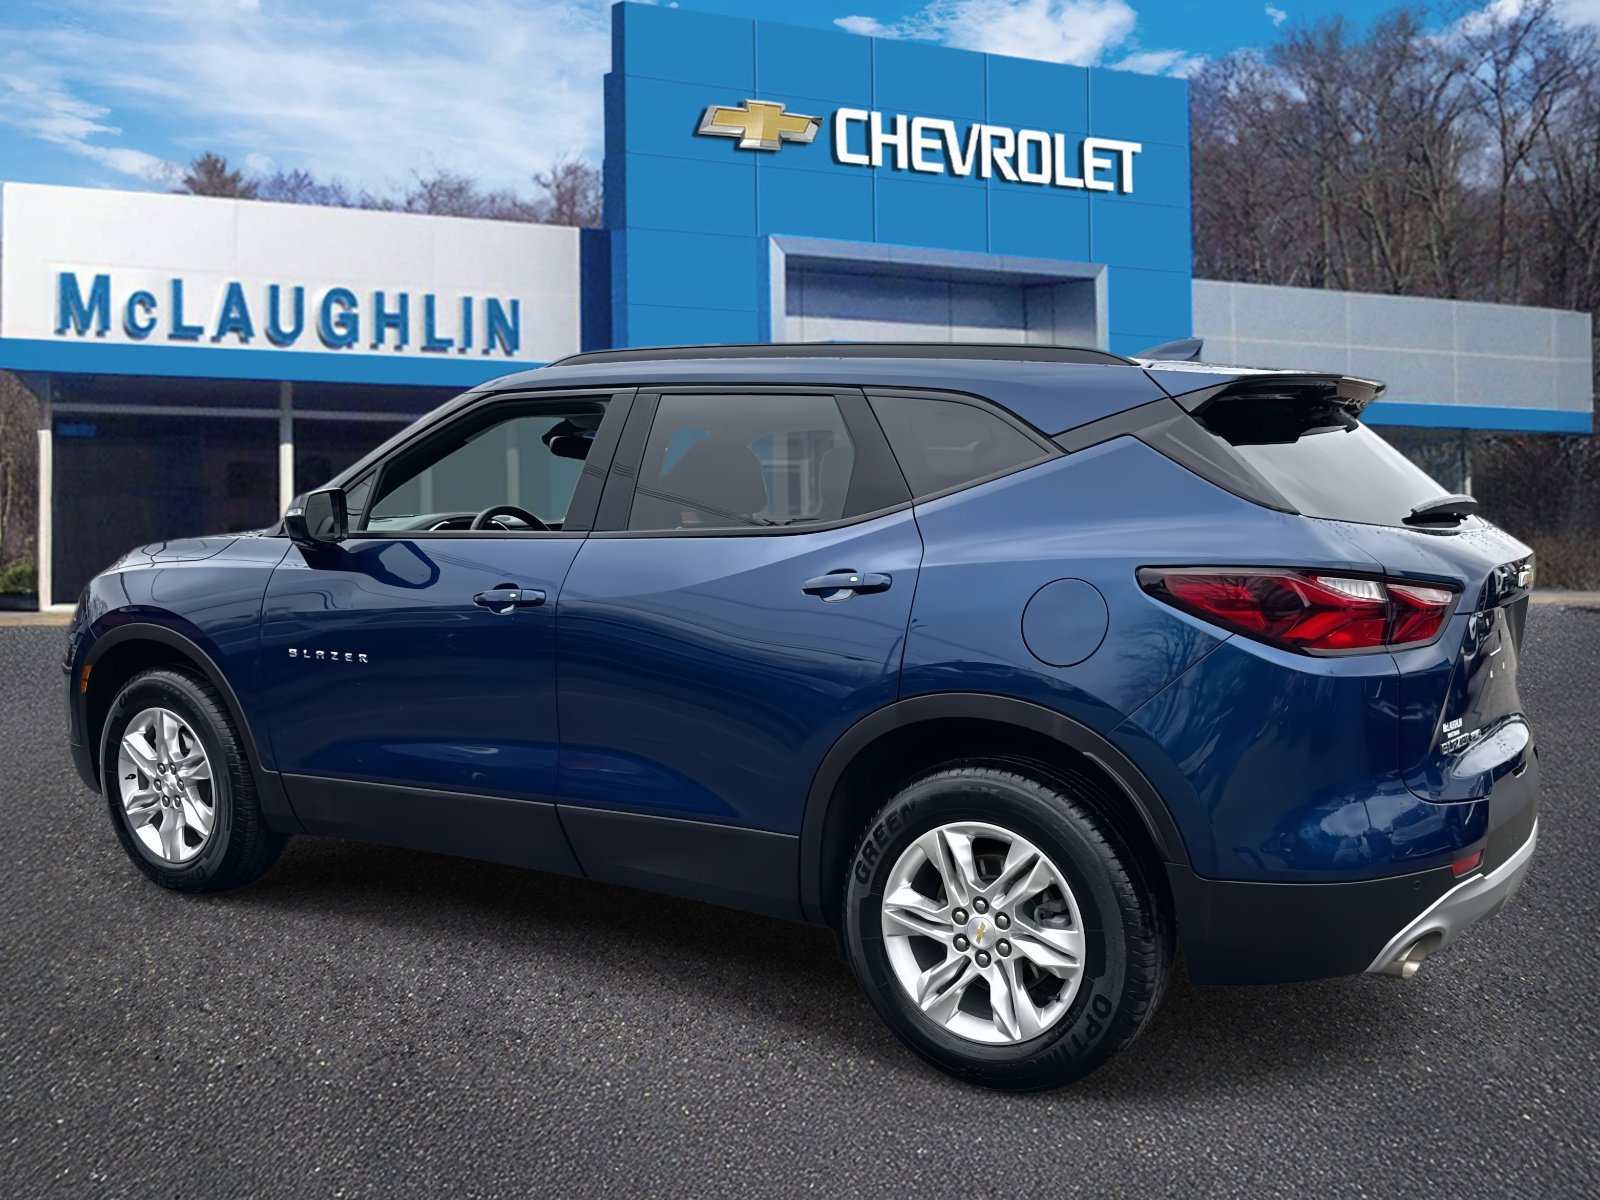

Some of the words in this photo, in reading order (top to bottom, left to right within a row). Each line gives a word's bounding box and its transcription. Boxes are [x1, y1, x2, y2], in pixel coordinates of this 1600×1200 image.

[835, 107, 1142, 193] CHEVROLET
[54, 272, 521, 356] McLAUGHLIN
[288, 648, 368, 663] BLAZER
[854, 801, 917, 884] GREEN
